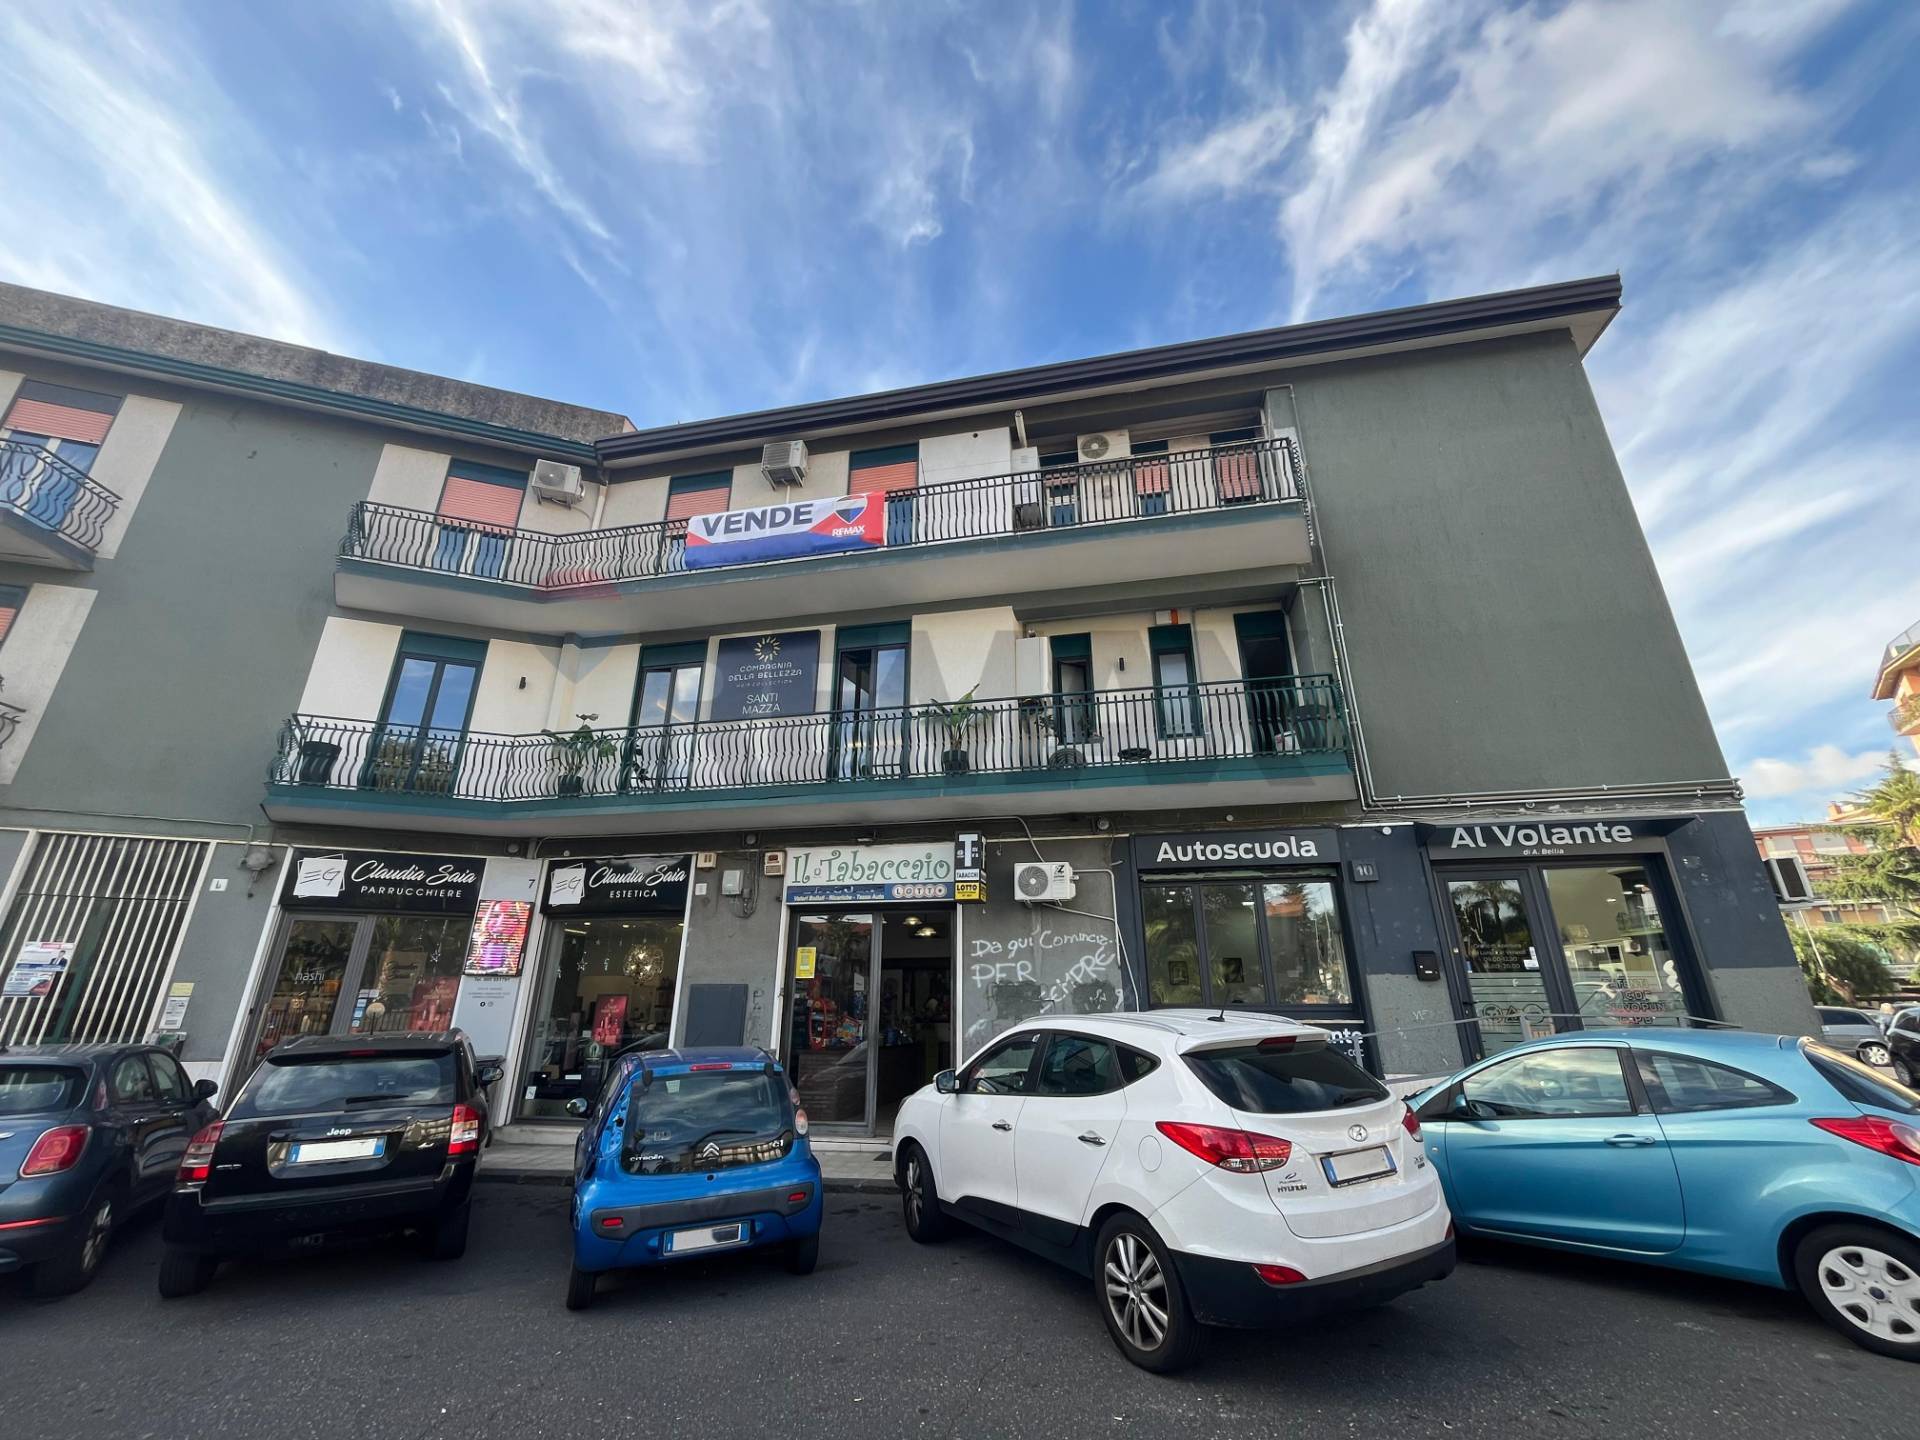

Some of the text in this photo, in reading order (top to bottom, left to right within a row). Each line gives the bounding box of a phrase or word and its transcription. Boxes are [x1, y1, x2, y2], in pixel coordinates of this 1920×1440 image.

[702, 503, 814, 537] VENDE
[740, 662, 792, 673] COMPAGNIA
[728, 669, 802, 682] DELLA BELLEZZA
[746, 693, 778, 704] SANTI
[742, 703, 780, 715] MAZZA
[1451, 823, 1633, 848] Al Volante
[1156, 836, 1319, 862] Autoscuola
[351, 860, 477, 886] Claudia Saia
[792, 850, 951, 884] Il Tabaccaio
[1356, 864, 1374, 877] 10
[588, 864, 687, 888] Claudia Saia
[956, 871, 979, 879] TABACCHI
[528, 879, 536, 889] 7
[957, 884, 978, 892] LOTTO
[360, 885, 462, 898] PARRUCCHIERE
[609, 889, 657, 898] ESTETICA
[971, 940, 1002, 957] Da
[295, 969, 325, 982] nashi
[326, 1127, 352, 1137] Jeep
